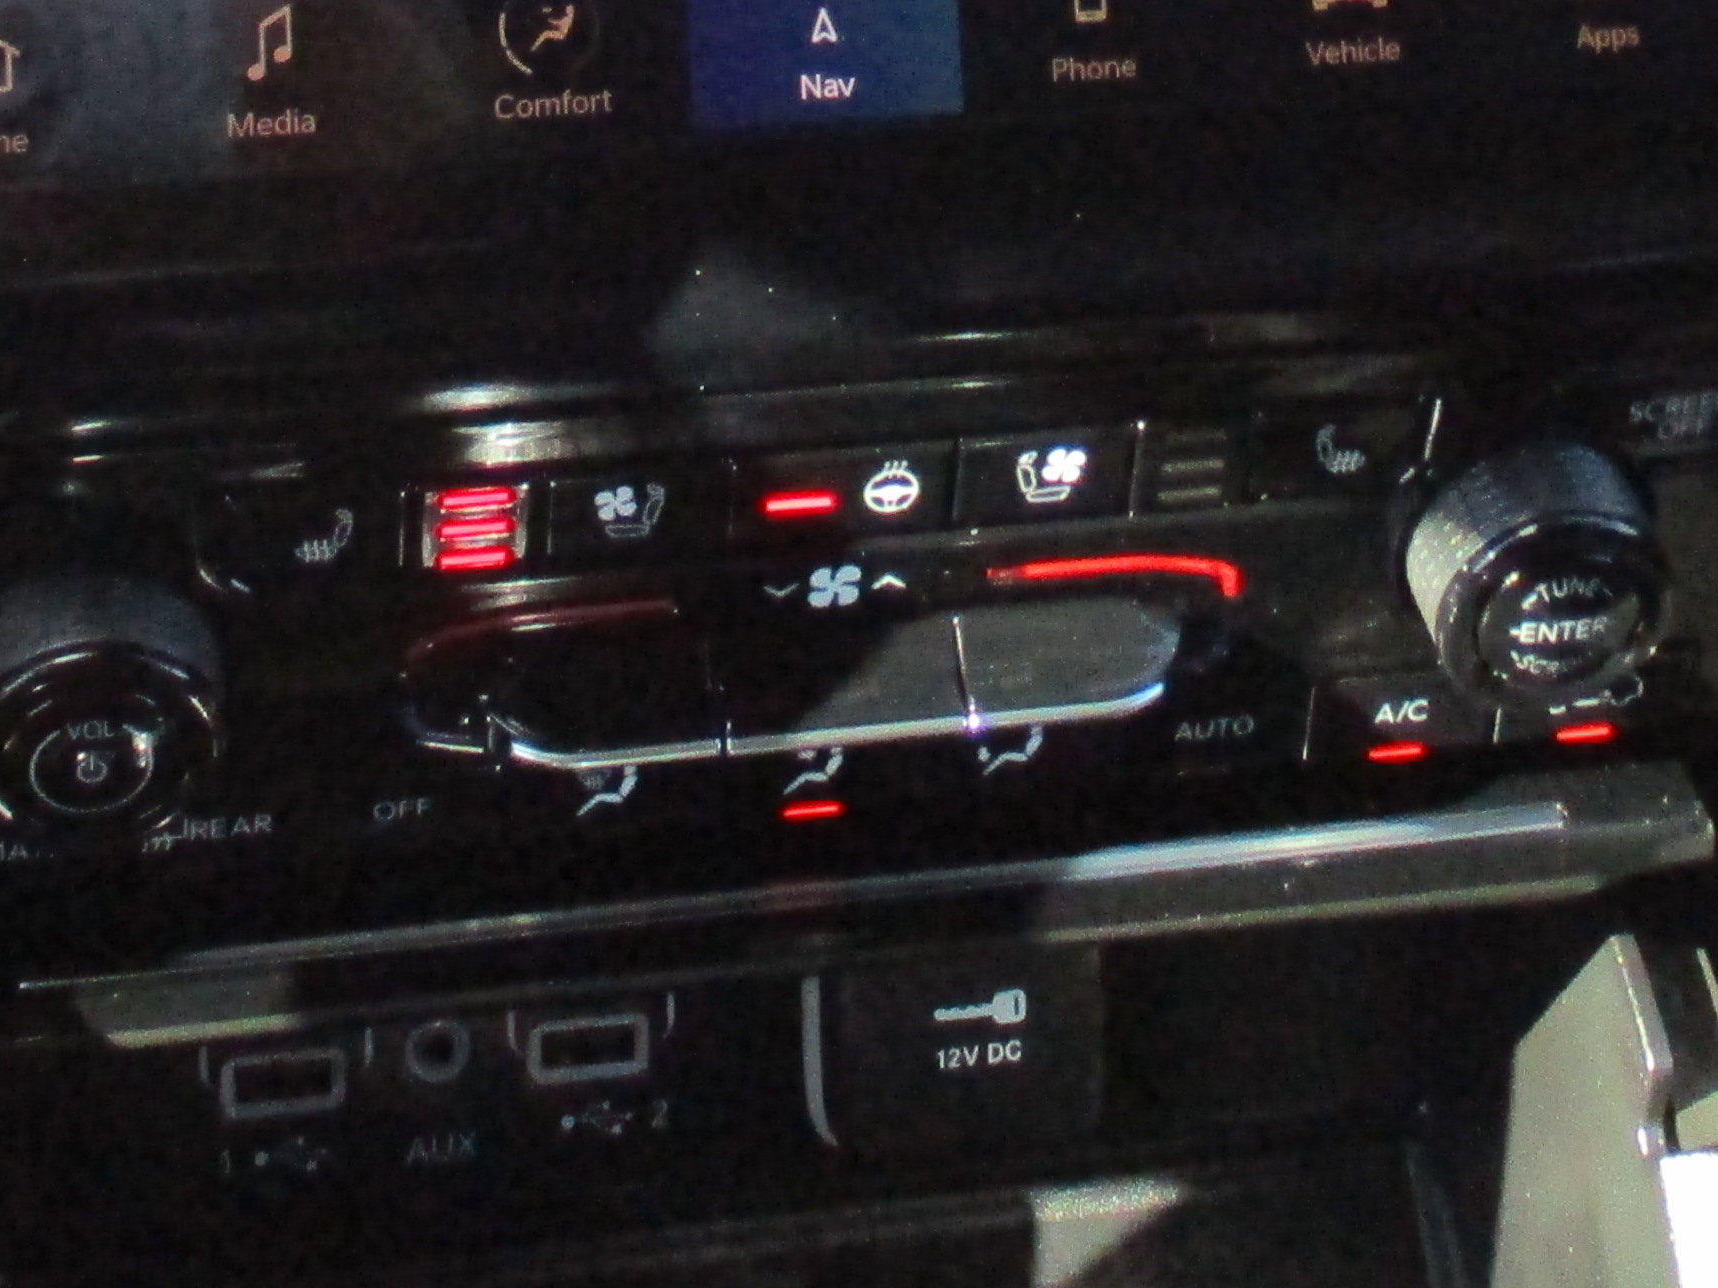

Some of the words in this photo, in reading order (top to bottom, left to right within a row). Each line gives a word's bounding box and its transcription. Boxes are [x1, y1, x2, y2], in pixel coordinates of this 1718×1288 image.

[1305, 35, 1401, 67] Vehicle
[1576, 23, 1640, 56] Apps
[1051, 53, 1137, 84] Phone
[799, 71, 856, 102] Nav
[494, 88, 613, 121] Comfort
[227, 108, 317, 139] Media
[1519, 615, 1609, 646] ENTER
[1374, 698, 1428, 725] A/C
[1174, 714, 1255, 742] AUTO
[372, 796, 433, 822] OFF
[189, 813, 273, 841] REAR
[935, 1044, 982, 1069] 12V
[987, 1041, 1023, 1066] DC
[405, 1130, 477, 1165] AUX
